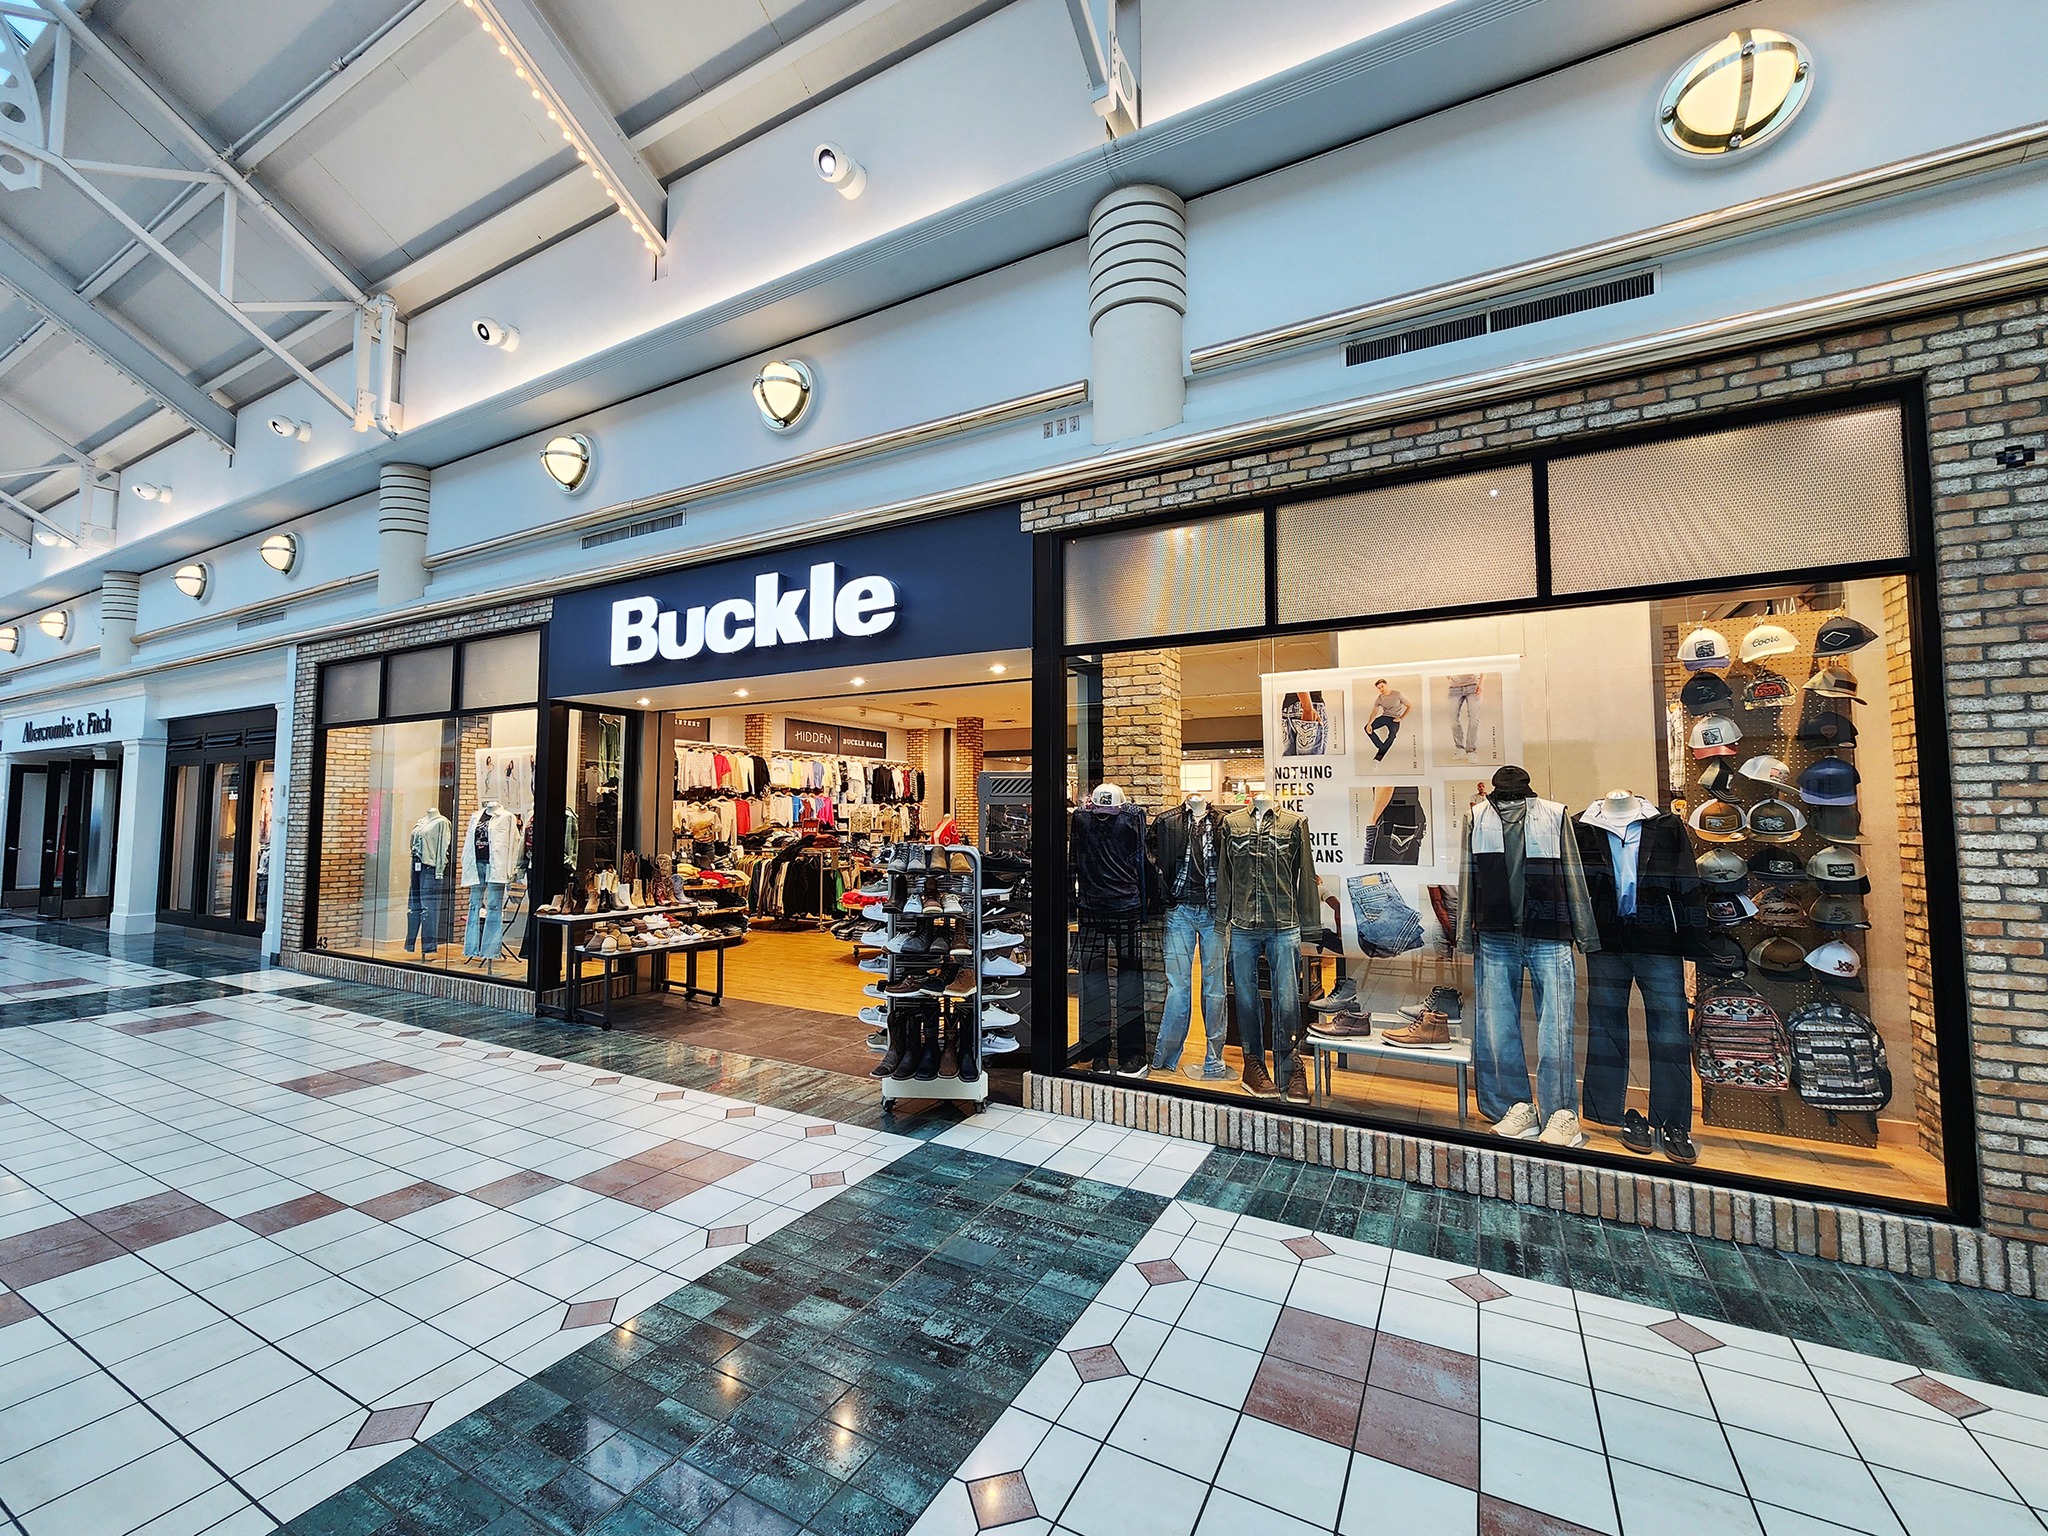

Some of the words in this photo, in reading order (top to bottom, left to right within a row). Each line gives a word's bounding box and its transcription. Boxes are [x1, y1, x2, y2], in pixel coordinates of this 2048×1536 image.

[610, 561, 898, 667] Buckle
[22, 715, 75, 743] Abercrombie
[76, 719, 85, 736] &
[86, 708, 112, 735] Fitch
[795, 730, 833, 744] HIDDEN
[842, 738, 864, 747] BUCKLE
[865, 741, 884, 749] BLACK
[1274, 765, 1333, 780] NOTHING
[1274, 782, 1315, 797] FEELS
[1281, 799, 1305, 813] IKE
[1308, 832, 1339, 847] RITE
[1311, 849, 1344, 863] ANS
[317, 936, 329, 949] 43
